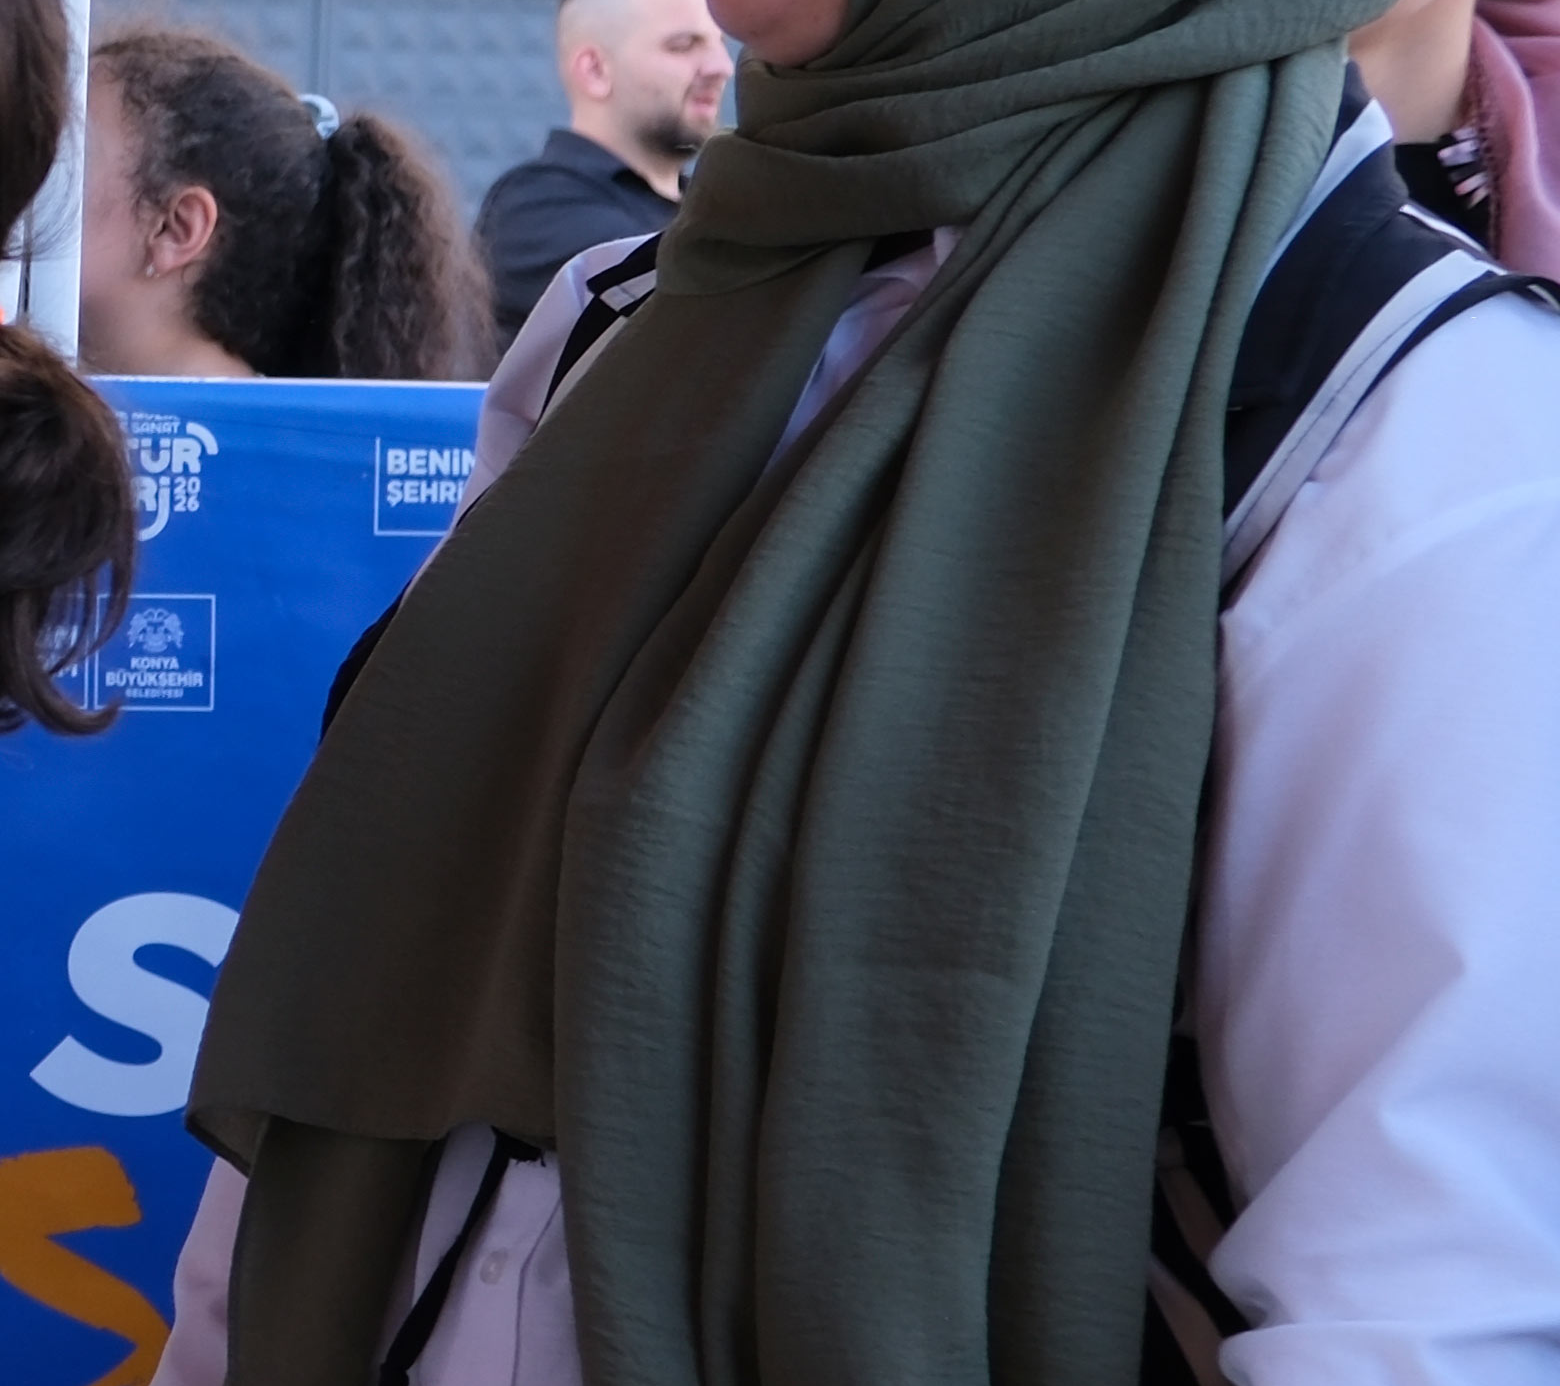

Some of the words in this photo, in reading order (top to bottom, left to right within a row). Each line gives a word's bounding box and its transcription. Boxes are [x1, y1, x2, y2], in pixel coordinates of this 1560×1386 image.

[173, 477, 201, 495] 20
[173, 495, 200, 512] 26
[130, 656, 179, 670] KONYA
[105, 669, 204, 687] BÜYÜKŞEHİR
